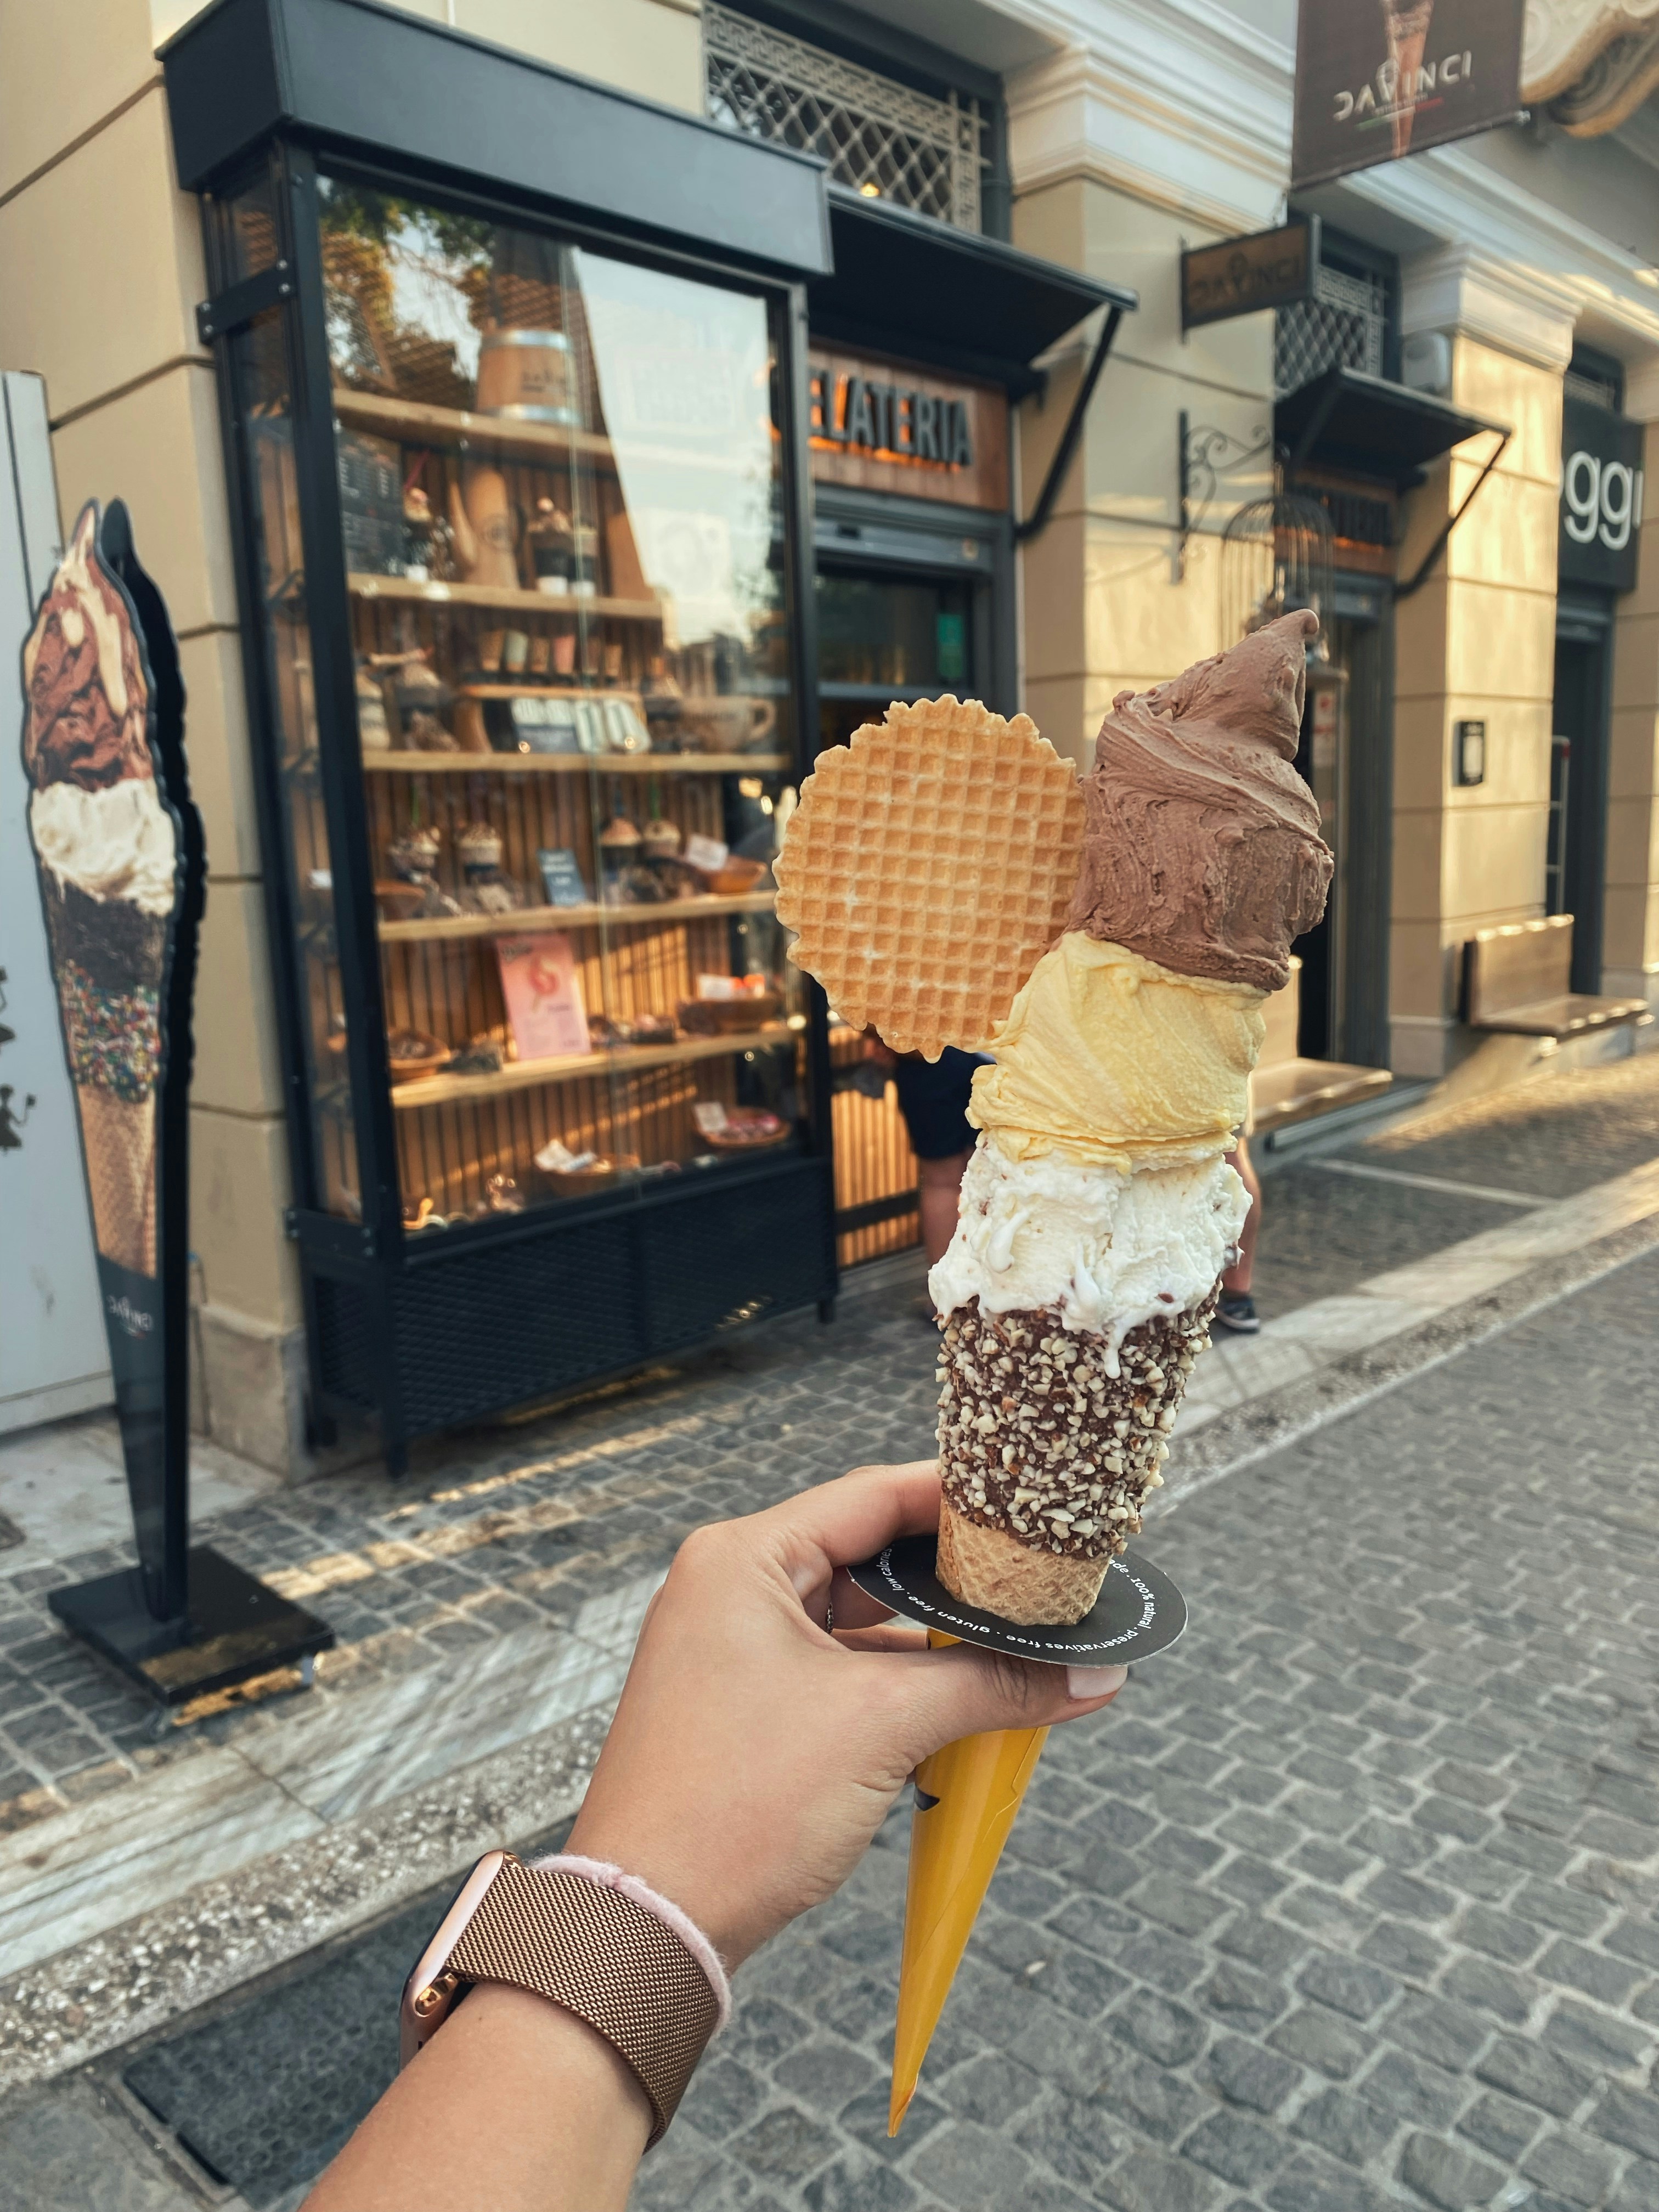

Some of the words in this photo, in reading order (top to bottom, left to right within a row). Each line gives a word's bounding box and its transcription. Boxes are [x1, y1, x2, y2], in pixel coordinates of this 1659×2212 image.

[1333, 50, 1472, 122] DAVINCI
[770, 364, 972, 467] ELATERIA
[885, 1577, 905, 1591] low
[1130, 1577, 1155, 1600] 100%
[908, 1595, 935, 1611] free
[937, 1611, 990, 1633] gluten
[1137, 1601, 1156, 1629] natural
[1006, 1634, 1041, 1649] free
[1045, 1629, 1139, 1652] preservatives
